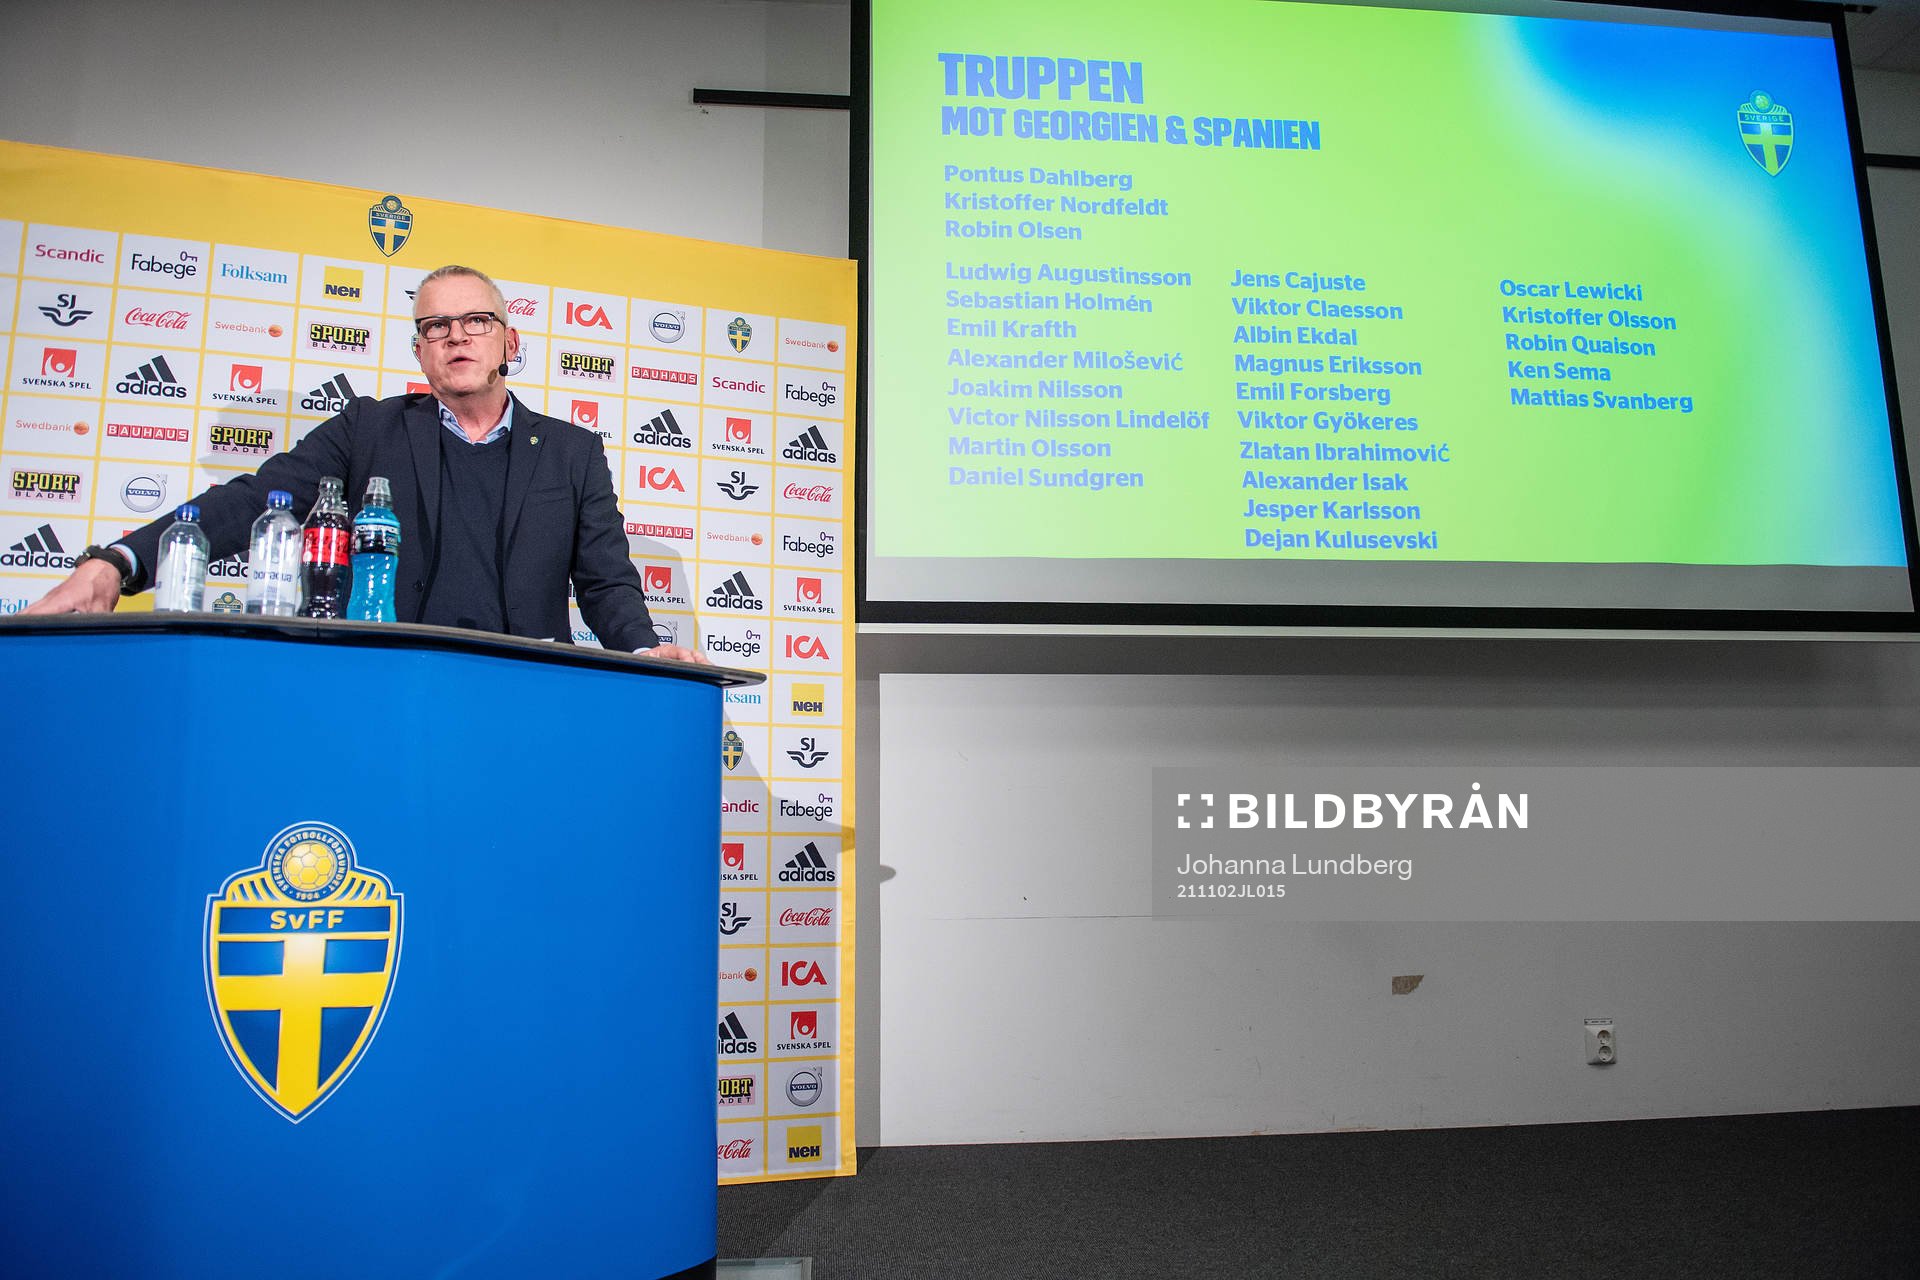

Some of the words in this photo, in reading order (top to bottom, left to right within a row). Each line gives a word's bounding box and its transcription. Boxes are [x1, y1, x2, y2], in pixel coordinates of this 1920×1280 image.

[938, 52, 1144, 104] TRUPPEN
[941, 105, 1006, 136] MOT
[1013, 109, 1158, 143] GEORGIEN
[1165, 115, 1188, 145] &
[1194, 116, 1321, 150] SPANIEN
[944, 165, 1024, 183] Pontus
[1030, 167, 1133, 191] Dahlberg
[945, 192, 1055, 212] Kristoffer
[1060, 195, 1168, 216] Nordfeldt
[945, 220, 1012, 238] Robin
[1018, 221, 1082, 240] Olsen
[35, 244, 104, 264] Scandic
[131, 253, 197, 280] Fabege
[221, 263, 288, 284] Folksam
[946, 262, 1031, 284] Ludwig
[1037, 263, 1191, 286] Augustinsson
[1231, 270, 1280, 288] Jens
[1285, 272, 1366, 293] Cajuste
[1500, 279, 1560, 297] Oscar
[1564, 281, 1643, 301] Lewicki
[57, 294, 77, 308] SJ
[946, 290, 1058, 309] Sebastian
[1065, 292, 1152, 312] Holmén
[1232, 297, 1301, 316] Viktor
[1306, 300, 1403, 319] Claesson
[566, 302, 613, 330] ICA
[654, 322, 680, 330] VOLVO
[1502, 306, 1603, 326] Kristoffer
[1608, 310, 1677, 330] Olsson
[215, 321, 267, 336] Swedbank
[310, 324, 369, 346] SPORT
[947, 318, 996, 337] Emil
[1003, 320, 1077, 338] Krafth
[1233, 325, 1292, 344] Albin
[1297, 326, 1357, 345] Ekdal
[312, 342, 366, 353] BLADET
[785, 337, 826, 350] Swedbank
[1505, 333, 1567, 352] Robin
[1571, 335, 1656, 356] Quaison
[561, 354, 614, 373] SPORT
[948, 349, 1068, 368] Alexander
[1073, 350, 1183, 371] Milošević
[1234, 354, 1324, 376] Magnus
[1329, 355, 1422, 375] Eriksson
[563, 370, 611, 380] BLADET
[632, 367, 697, 385] BAUHAUS
[1508, 361, 1550, 379] Ken
[1553, 362, 1611, 381] Sema
[22, 377, 66, 388] SVENSKA
[69, 381, 92, 390] SPEL
[116, 379, 187, 399] adidas
[712, 377, 766, 394] Scandic
[948, 378, 1032, 398] Joakim
[1038, 380, 1123, 399] Nilsson
[212, 393, 253, 404] SVENSKA
[256, 397, 278, 406] SPEL
[785, 384, 836, 407] Fabege
[1236, 382, 1284, 400] Emil
[1290, 382, 1391, 406] Forsberg
[1510, 388, 1589, 407] Mattias
[1592, 391, 1694, 414] Svanberg
[301, 397, 345, 412] adid
[15, 419, 71, 434] Swedbank
[948, 407, 1019, 427] Victor
[1025, 409, 1110, 428] Nilsson
[1116, 410, 1210, 429] Lindelöf
[1237, 410, 1308, 429] Viktor
[1313, 411, 1418, 433] Gyökeres
[107, 424, 189, 442] BAUHAUS
[210, 426, 273, 448] SPORT
[633, 431, 691, 449] adidas
[212, 444, 269, 455] BLADET
[712, 444, 745, 452] SVENSKA
[748, 447, 765, 455] SPEL
[782, 447, 836, 463] adidas
[948, 436, 1026, 456] Martin
[1031, 439, 1111, 457] Olsson
[1240, 441, 1310, 460] Zlatan
[1315, 443, 1450, 462] Ibrahimović
[13, 472, 80, 492] SPORT
[639, 465, 685, 492] ICA
[731, 471, 745, 484] SJ
[948, 466, 1023, 486] Daniel
[1028, 468, 1144, 491] Sundgren
[1242, 470, 1358, 490] Alexander
[1363, 473, 1409, 491] Isak
[15, 491, 74, 501] BLADET
[127, 489, 160, 497] VOLVO
[1243, 499, 1318, 521] Jesper
[1323, 500, 1421, 520] Karlsson
[626, 522, 693, 539] BAUHAUS
[706, 532, 750, 542] Swedbank
[1245, 528, 1310, 551] Dejan
[1315, 530, 1438, 549] Kulusevski
[783, 535, 834, 558] Fabege
[1, 551, 75, 568] adidas
[667, 596, 685, 604] SPEL
[706, 595, 763, 611] adidas
[783, 605, 816, 613] SVENSKA
[707, 634, 761, 658] Fabege
[785, 635, 829, 660] ICA
[725, 690, 761, 704] ksam
[800, 737, 814, 751] SJ
[722, 799, 759, 812] andic
[780, 800, 833, 821] Fabege
[272, 848, 289, 892] SVENSKA
[778, 868, 835, 882] adidas
[296, 892, 320, 900] 1904
[270, 910, 345, 930] SvFF
[721, 903, 736, 917] SJ
[782, 960, 827, 986] ICA
[720, 1040, 757, 1054] idas
[777, 1043, 811, 1051] SVENSKA
[812, 1041, 831, 1049] SPEL
[720, 1079, 752, 1097] ORT
[792, 1083, 817, 1091] VOLVO
